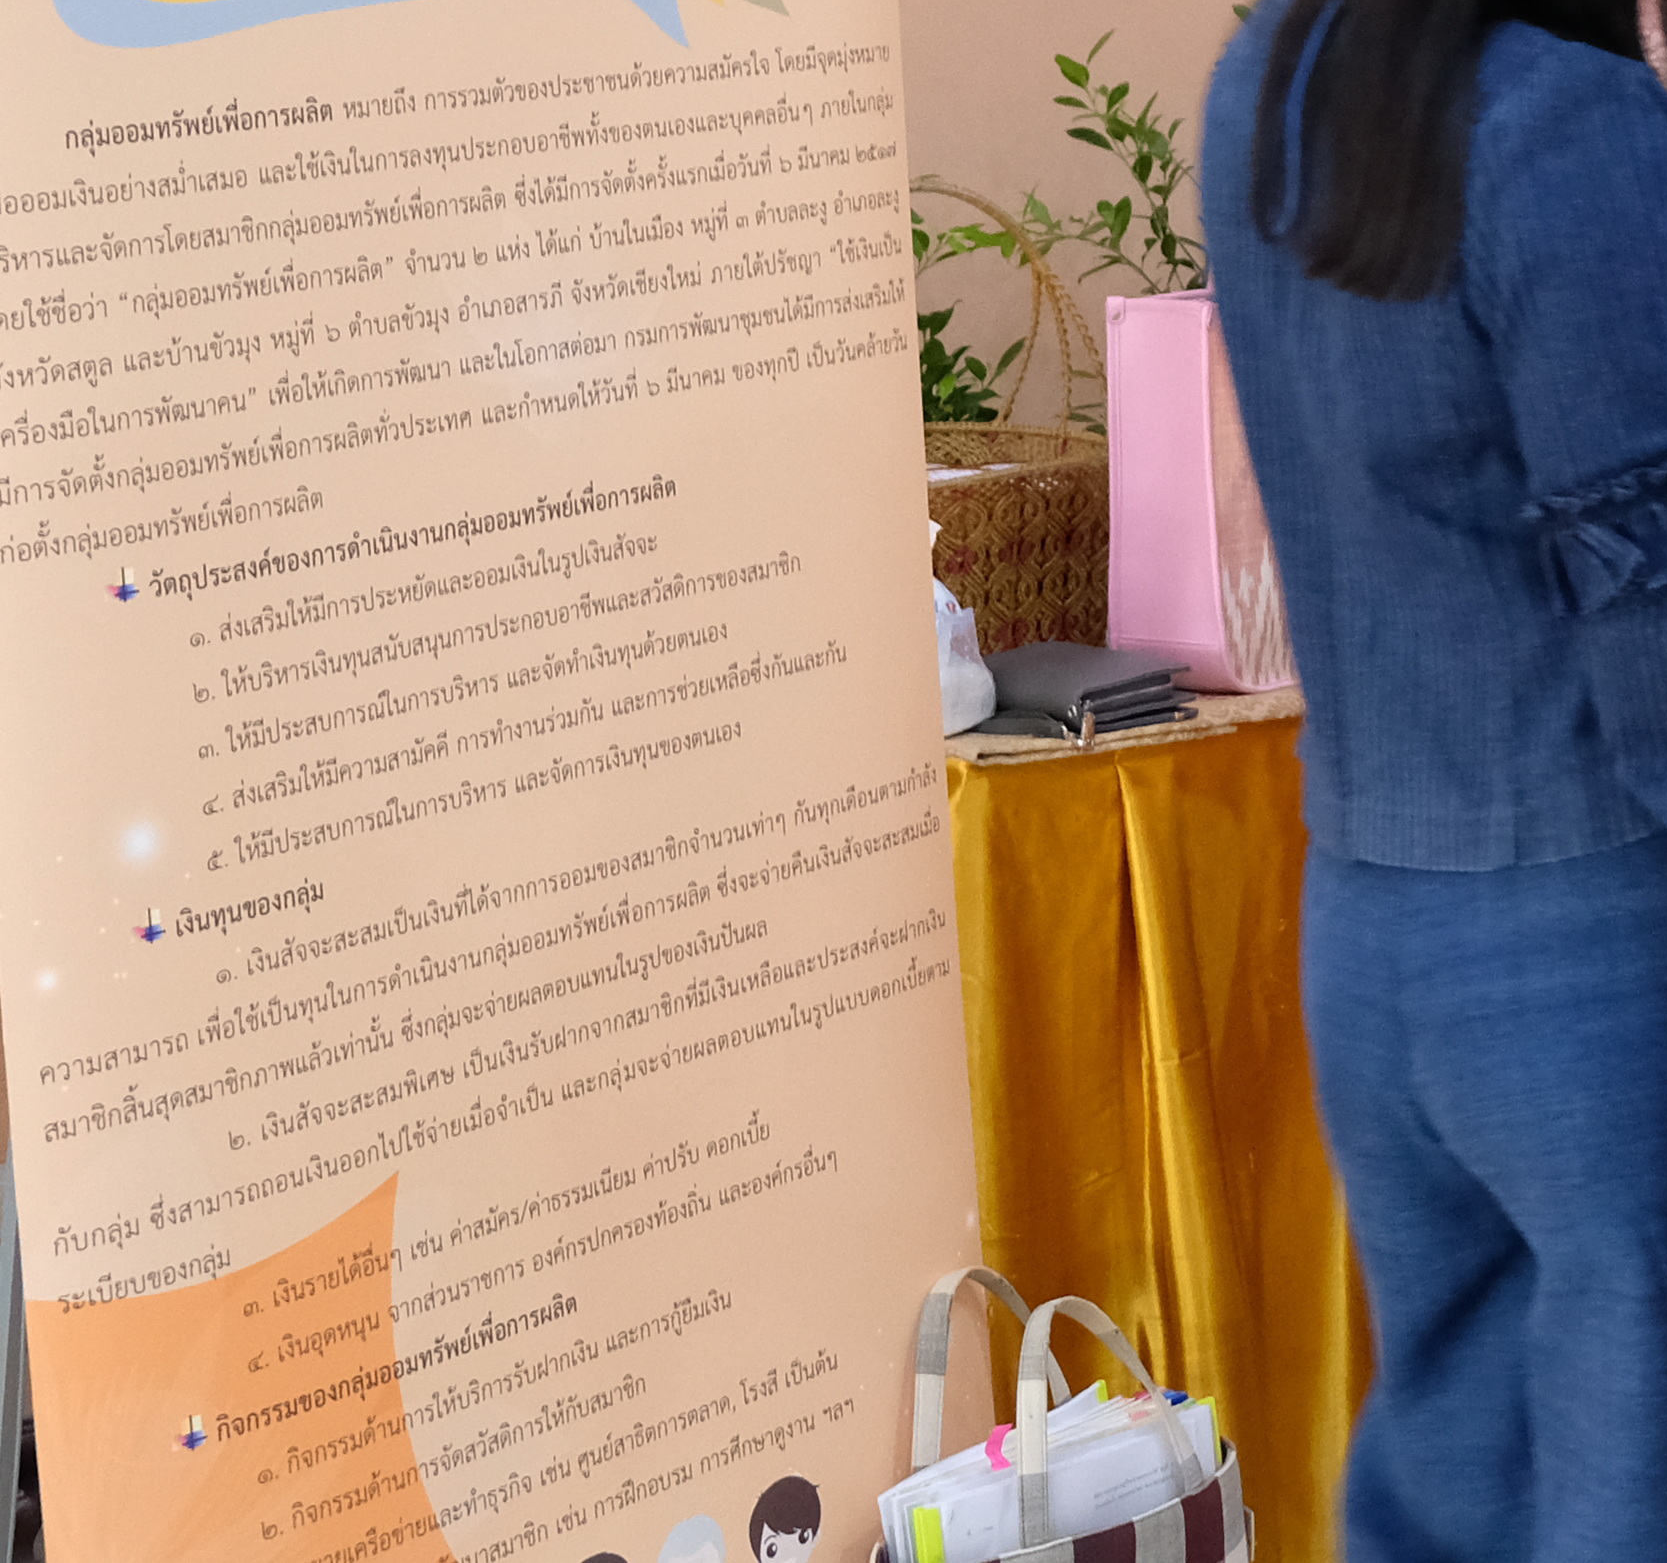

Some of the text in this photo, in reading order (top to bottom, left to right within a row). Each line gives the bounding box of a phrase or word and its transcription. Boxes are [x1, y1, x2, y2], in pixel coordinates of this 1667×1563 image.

[342, 86, 416, 119] หมายถึง
[774, 42, 889, 75] โดยมีจุดมุ่งหมาย
[820, 87, 893, 119] ภายในกลุ่ม
[797, 145, 850, 171] มีนาคม
[855, 141, 896, 163] ๒๕๑๗
[405, 248, 466, 276] จำนวน
[496, 234, 530, 263] แห่ง
[535, 225, 581, 257] ได้แก่
[589, 214, 684, 250] บ้านในเมือง
[691, 200, 728, 242] หมู่ที่
[755, 200, 827, 226] ตำบลละงู
[833, 189, 899, 215] อำเภอละงู
[270, 311, 315, 357] หมู่ที่
[458, 280, 563, 322] อำเภอสารภี
[571, 260, 701, 305] จังหวัดเชียงใหม่
[711, 248, 821, 284] ภายใต้ปรัชญา
[269, 357, 451, 406] เพื่อให้เกิดการพัฒนา
[459, 331, 616, 375] และในโอกาสต่อมา
[482, 367, 638, 425] และกำหนดให้วันที่
[666, 365, 725, 393] มีนาคม
[732, 346, 799, 383] ของทุกปี
[807, 328, 908, 368] เป็นวันคล้ายวัน
[507, 623, 727, 689] และจัดทำเงินทุนด้วยตนเอง
[232, 729, 449, 809] ส่งเสริมให้มีความสามัคคี
[457, 697, 604, 754] การทำงานร่วมกัน
[515, 721, 741, 793] และจัดการเงินทุนของตนเอง
[794, 762, 937, 826] กันทุกเดือนตามกำลัง
[175, 877, 324, 938] เงินทุนของกลุ่ม
[40, 1033, 189, 1086] ความสามารถ
[261, 1066, 455, 1141] เงินสัจจะสะสมพิเศษ
[53, 1212, 140, 1257] กับกลุ่ม
[273, 1241, 402, 1307] เงินรายได้อื่นๆ
[410, 1229, 443, 1261] เช่น
[450, 1166, 636, 1247] ค่าสมัคร/ค่าธรรมเนียม
[643, 1140, 699, 1180] ค่าปรับ
[706, 1109, 770, 1158] ดอกเบี้ย
[57, 1243, 231, 1314] ระเบียบของกลุ่ม
[278, 1312, 380, 1363] เงินอุดหนุน
[387, 1259, 524, 1322] จากส่วนราชการ
[532, 1183, 711, 1272] องค์กรปกครองท้องถิ่น
[719, 1144, 837, 1206] และองค์กรอื่นๆ
[606, 1289, 732, 1353] และการกู้ยืมเงิน
[540, 1348, 838, 1487] เช่น ศูนย์สาธิตการตลาด, โรงสี เป็นต้น
[556, 1504, 587, 1535] เช่น
[594, 1463, 693, 1519] การฝึกอบรม
[700, 1414, 815, 1474] การศึกษาดูงาน
